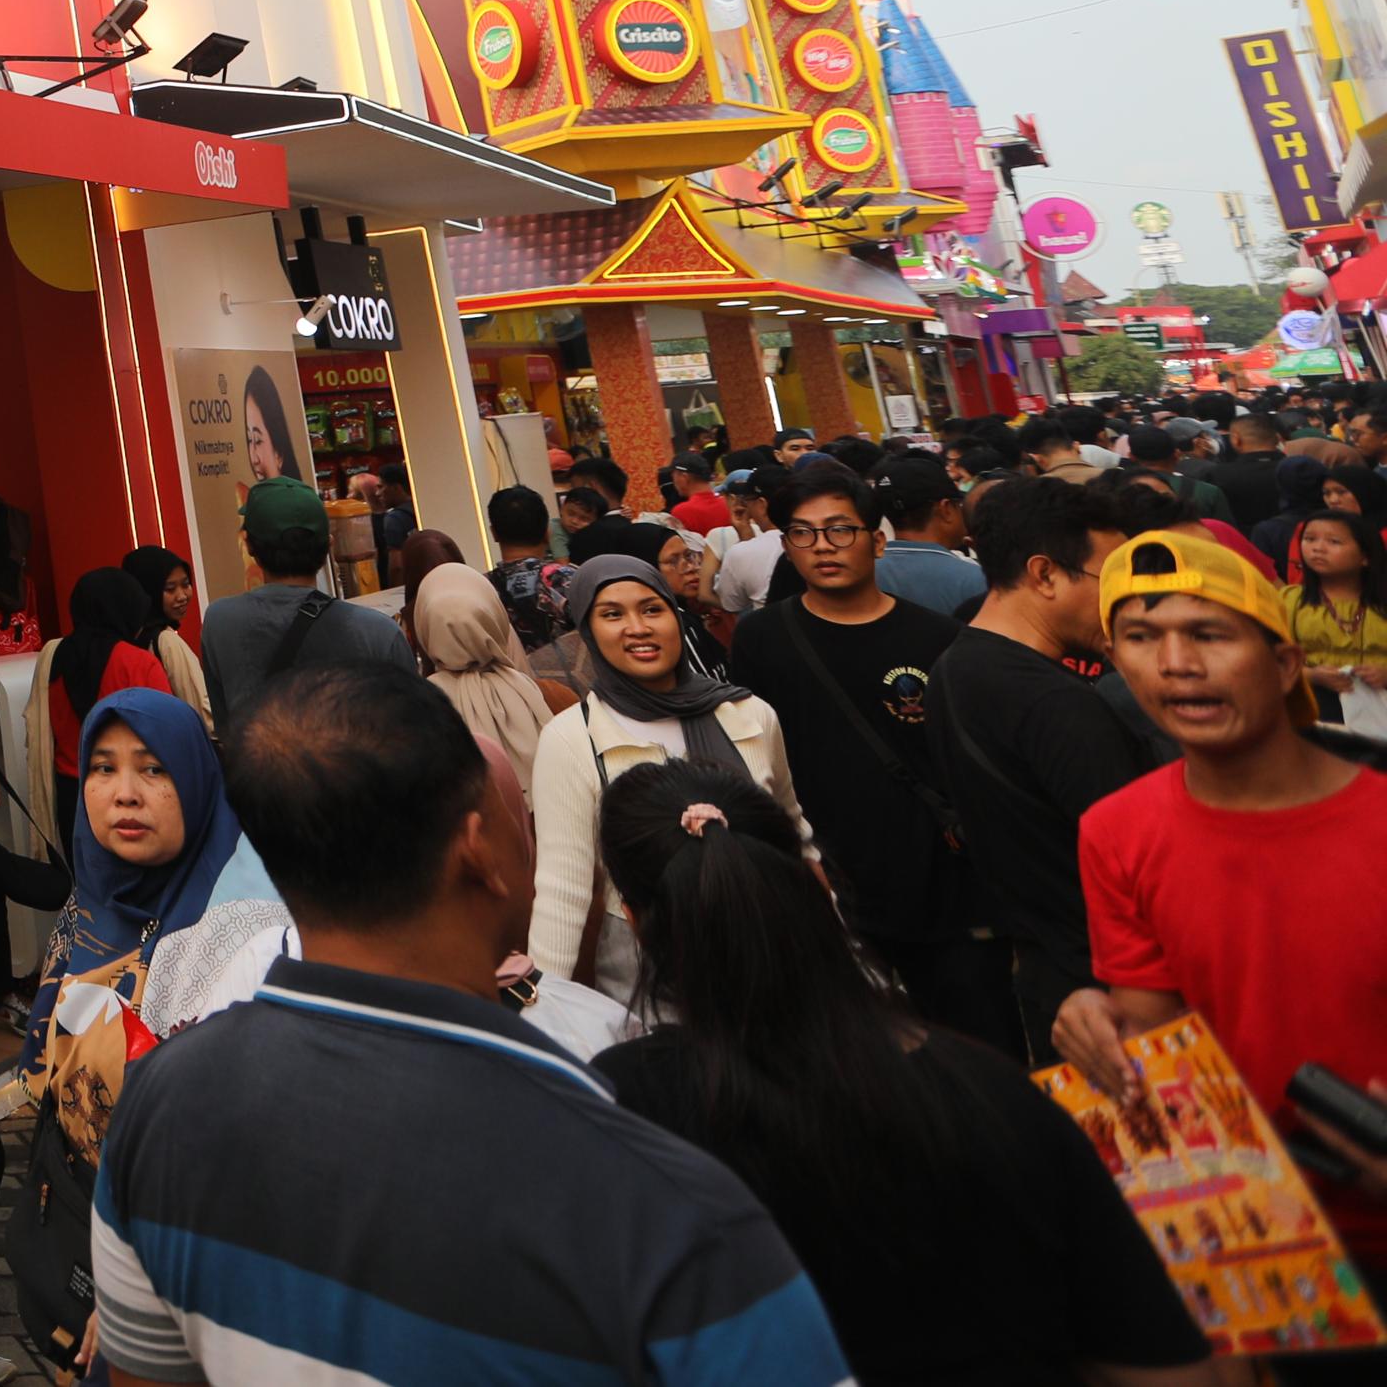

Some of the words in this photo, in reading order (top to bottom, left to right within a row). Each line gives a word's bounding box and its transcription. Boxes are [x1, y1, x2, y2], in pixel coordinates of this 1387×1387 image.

[484, 33, 513, 55] Frubee
[620, 26, 682, 45] Criscito
[194, 140, 237, 189] Oishi
[327, 294, 394, 342] COKRO
[314, 366, 387, 387] 10.000
[189, 399, 232, 425] COKRO
[194, 440, 234, 455] Nikmatnya
